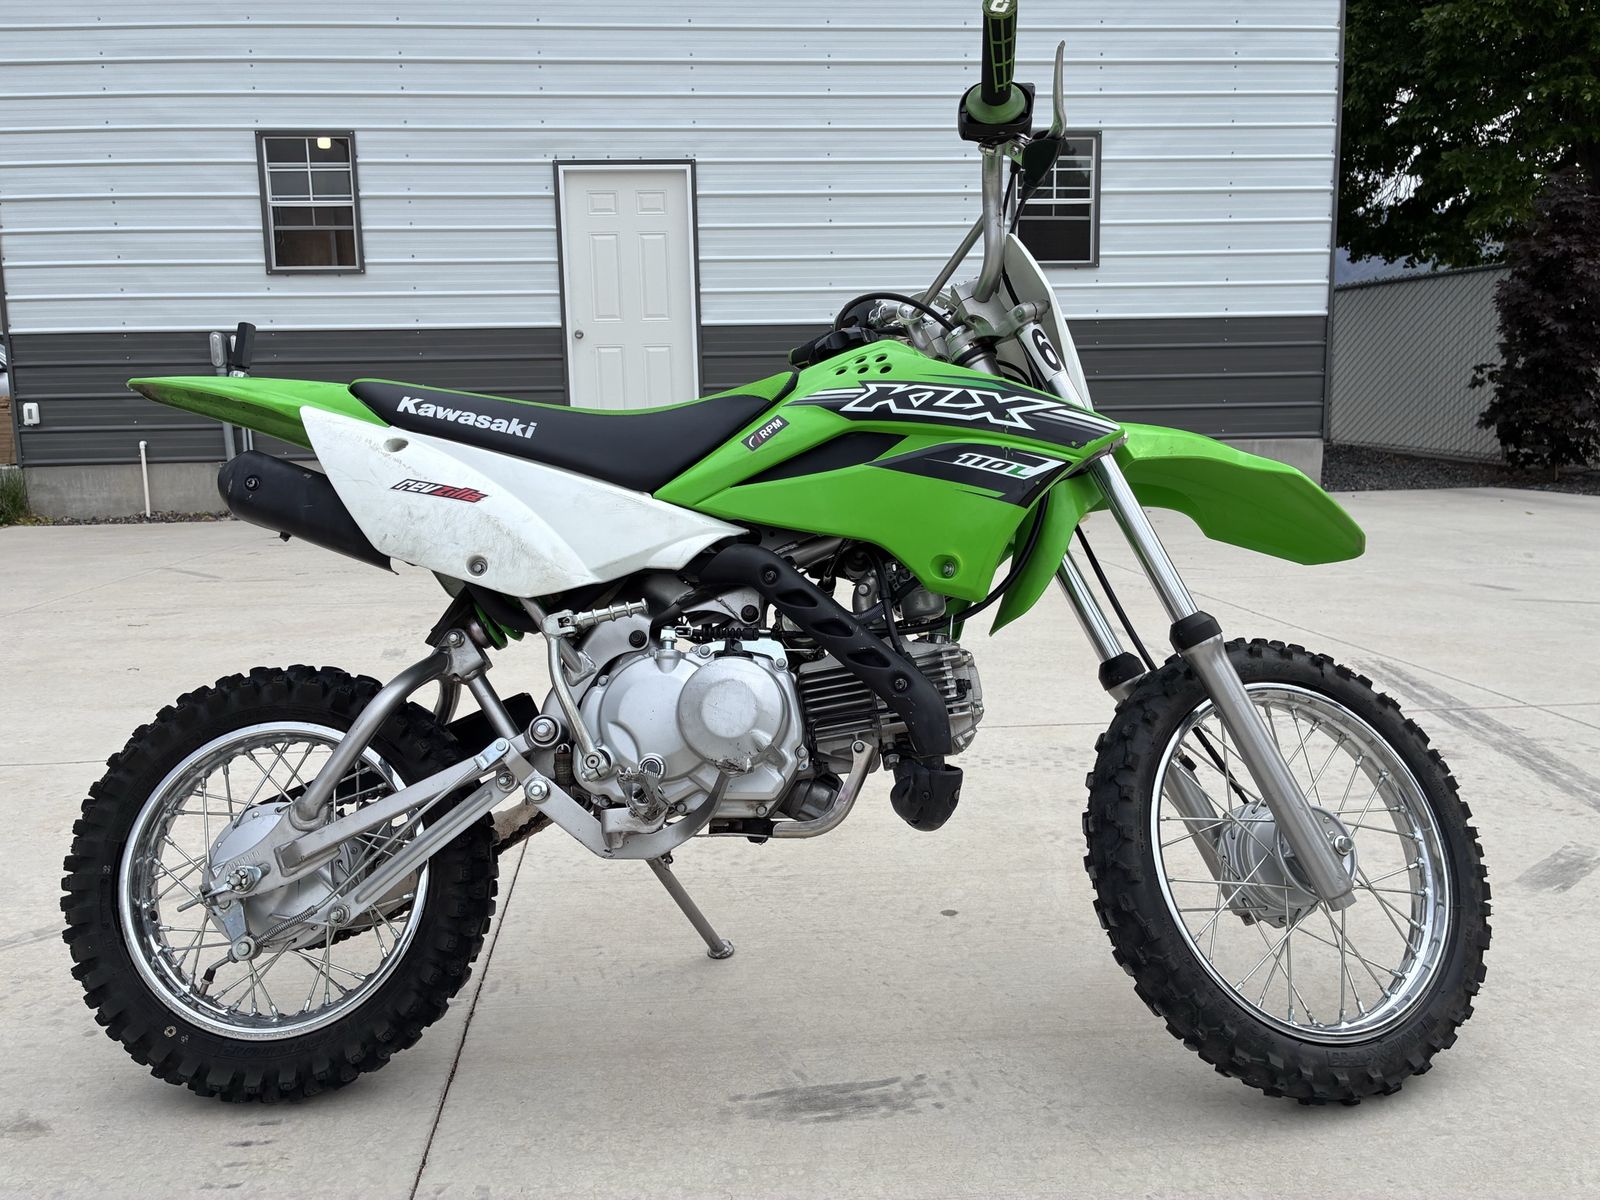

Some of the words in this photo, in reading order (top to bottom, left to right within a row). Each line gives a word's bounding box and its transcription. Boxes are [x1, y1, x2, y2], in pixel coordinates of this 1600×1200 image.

[1031, 328, 1062, 372] 6
[397, 396, 537, 439] Kawasaki
[759, 418, 783, 439] RPM
[840, 383, 1066, 431] KLX
[954, 453, 1031, 479] 110L
